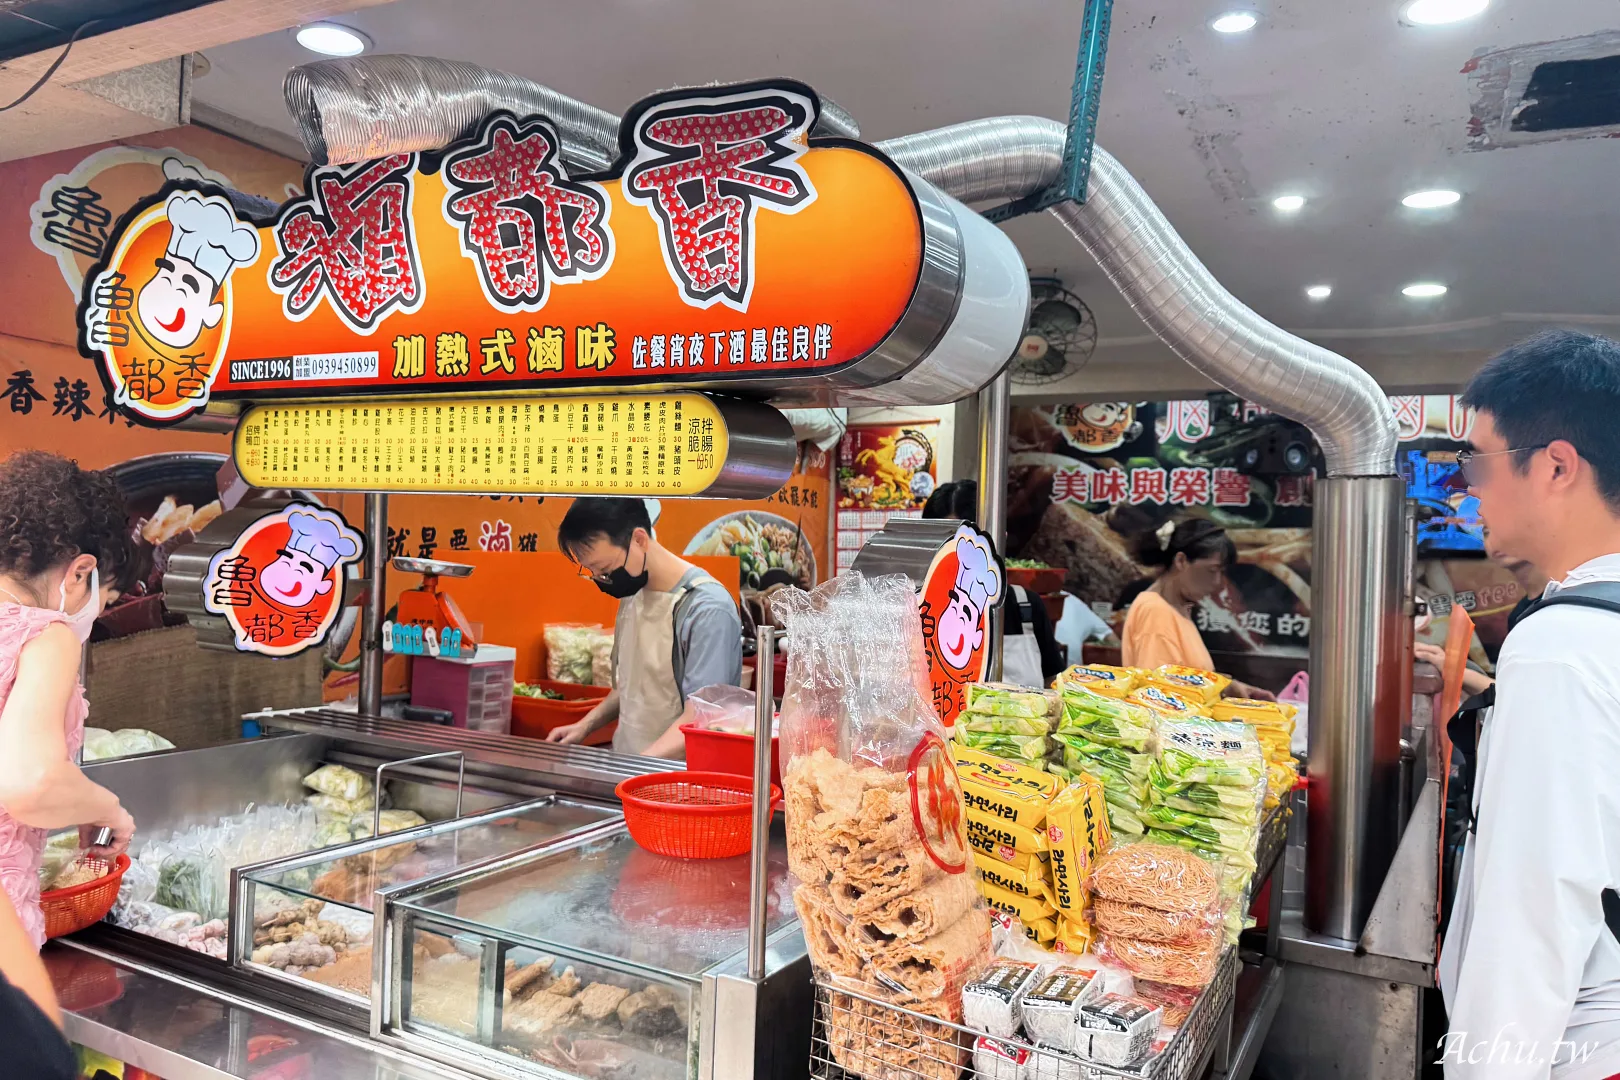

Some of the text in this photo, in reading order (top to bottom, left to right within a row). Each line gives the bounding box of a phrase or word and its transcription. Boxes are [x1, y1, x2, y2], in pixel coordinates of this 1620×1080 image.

[392, 323, 617, 378] 加熱式滷味
[630, 323, 833, 369] 佐餐宵夜下酒最佳良伴
[118, 352, 212, 402] 都香
[231, 359, 291, 381] SINCE1996
[312, 356, 377, 375] 0939450899
[0, 369, 135, 428] 香辣
[688, 417, 714, 434] 涼拌
[688, 436, 713, 452] 脆腸
[1050, 466, 1251, 506] 美味與榮譽
[242, 609, 323, 643] 都香
[964, 791, 1018, 823] 라면사리
[1052, 848, 1071, 909] 라면사리
